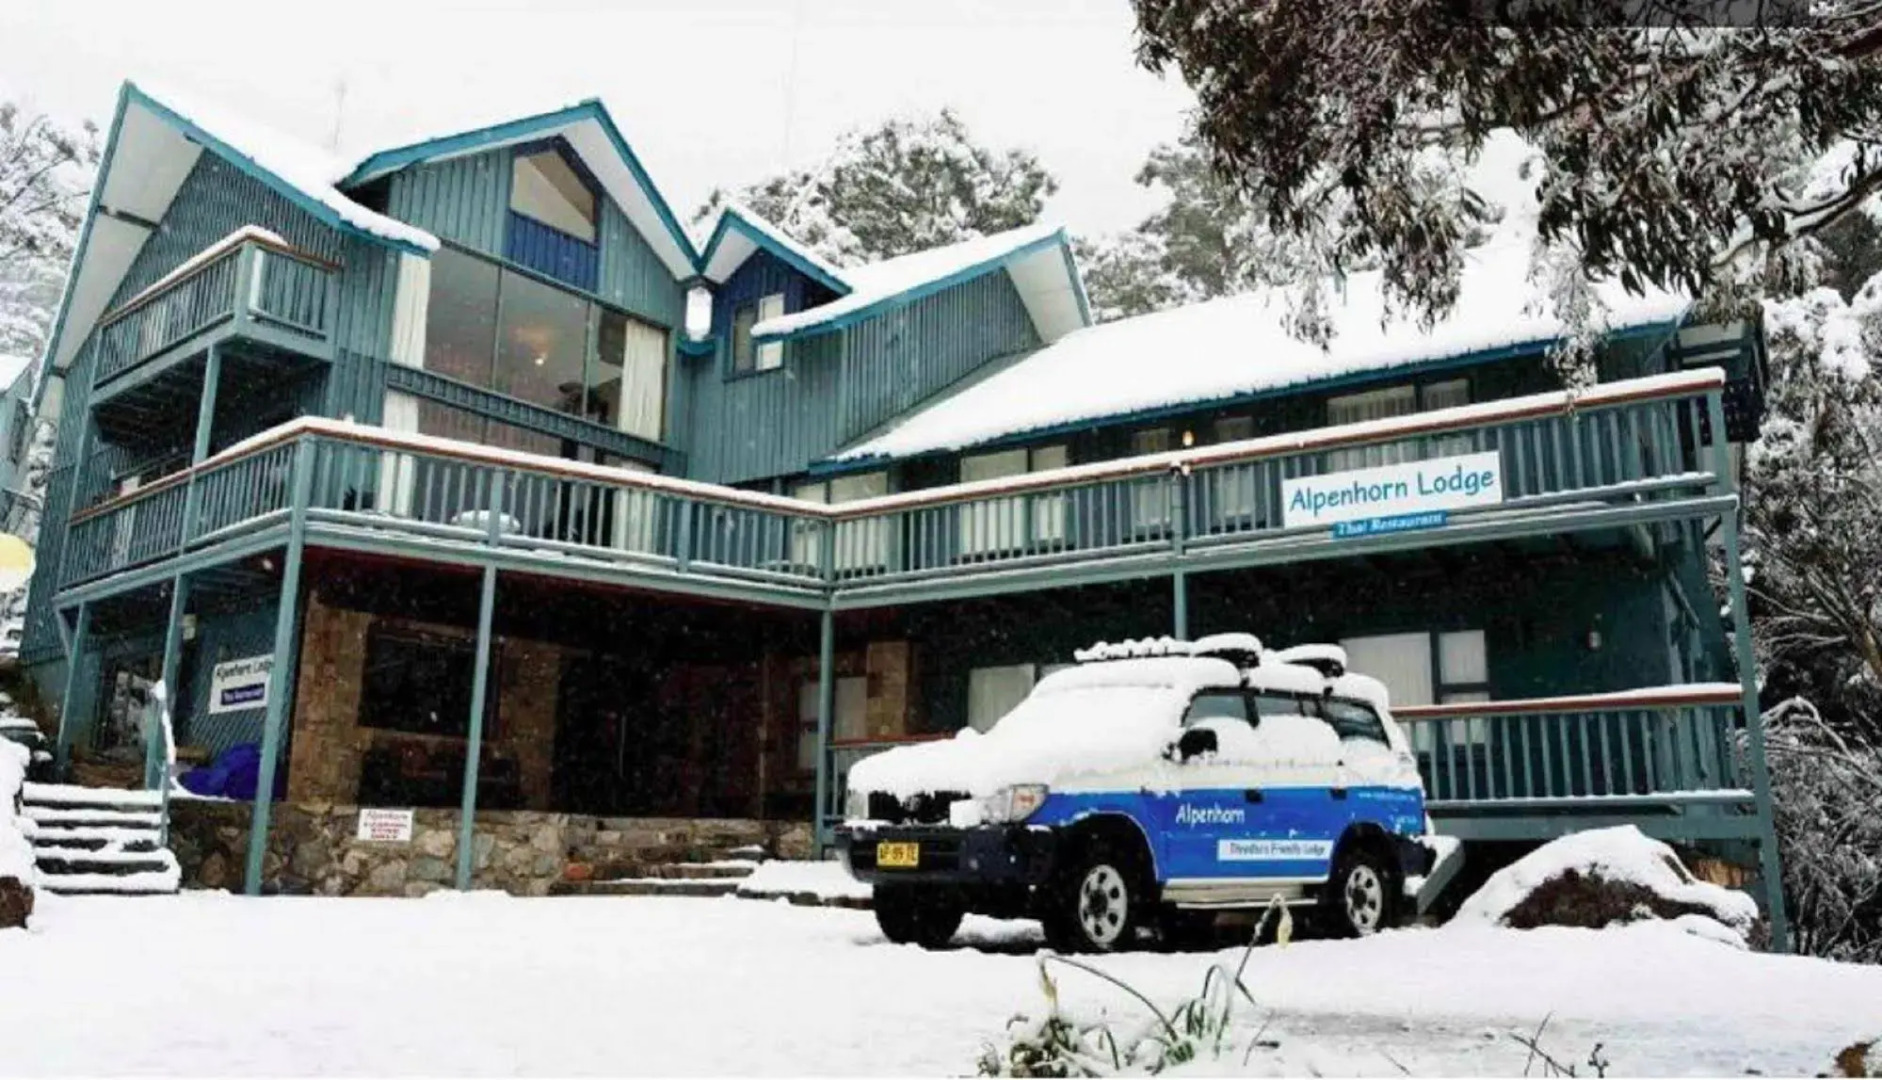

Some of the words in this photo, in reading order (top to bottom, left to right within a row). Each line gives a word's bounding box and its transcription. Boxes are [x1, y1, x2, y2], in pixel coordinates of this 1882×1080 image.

[1289, 480, 1408, 516] Alpenhorn
[1417, 465, 1495, 496] Lodge
[1175, 801, 1246, 829] Alpenhorn
